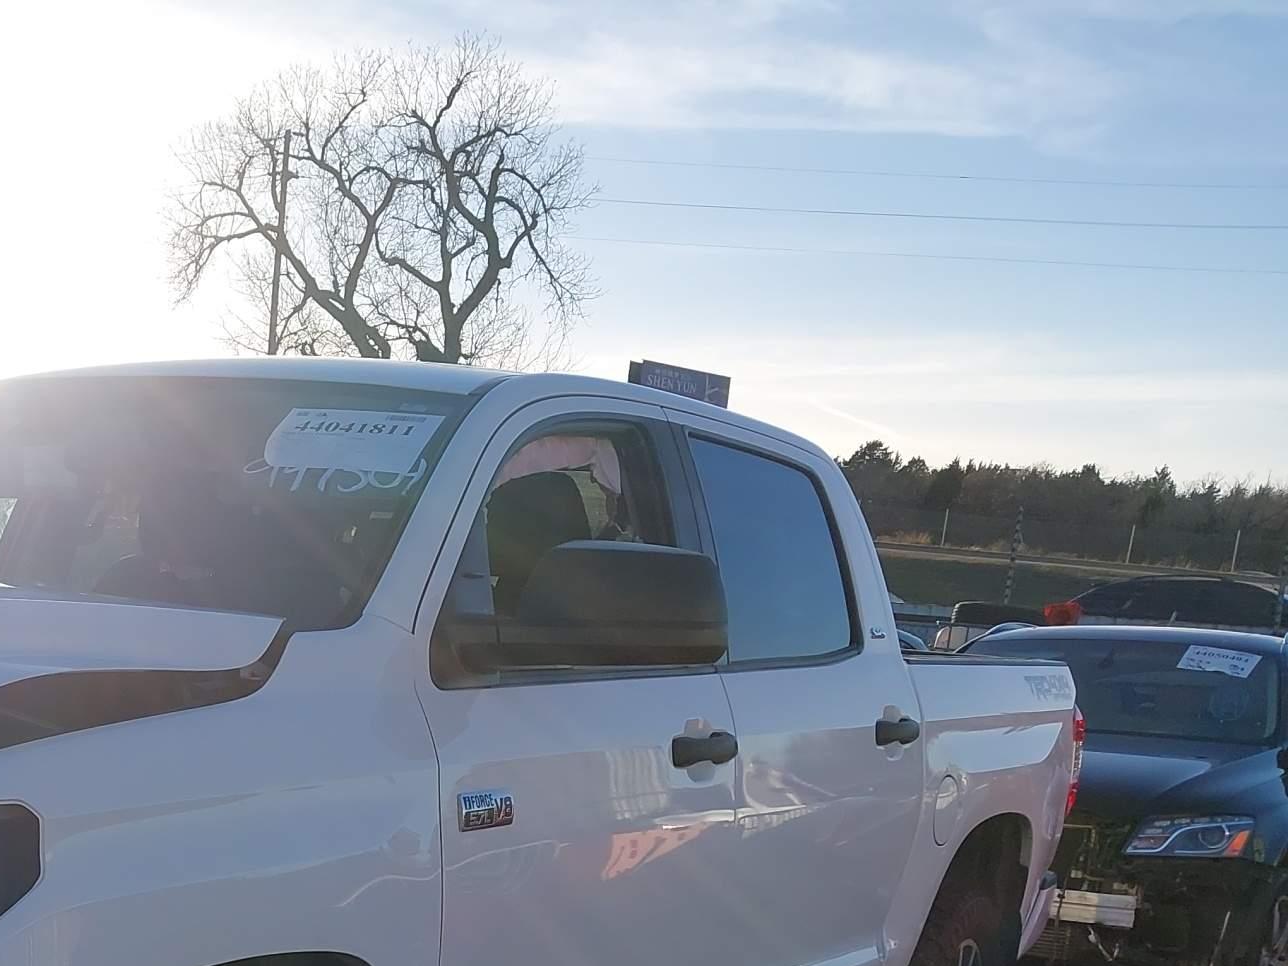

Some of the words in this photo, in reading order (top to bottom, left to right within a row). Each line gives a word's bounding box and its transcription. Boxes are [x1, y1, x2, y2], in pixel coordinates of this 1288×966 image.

[647, 374, 672, 392] SHEN
[674, 379, 697, 394] YUN
[295, 420, 415, 436] 44041811
[494, 796, 513, 818] V8
